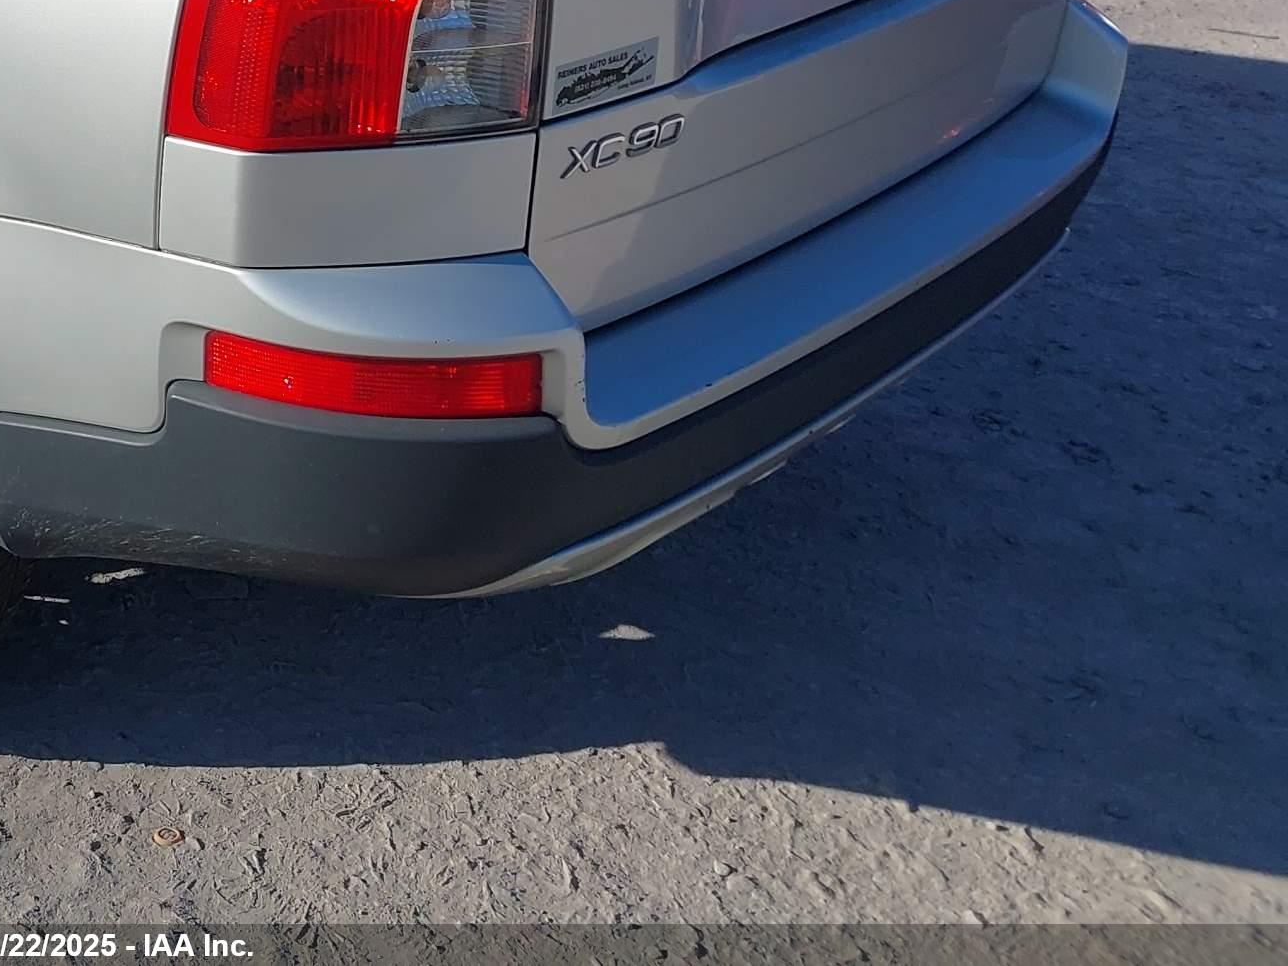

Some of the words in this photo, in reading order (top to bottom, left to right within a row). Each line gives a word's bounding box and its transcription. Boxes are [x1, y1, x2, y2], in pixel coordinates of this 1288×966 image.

[588, 57, 607, 71] AUTO
[608, 52, 628, 65] SALES
[560, 113, 685, 179] XC90
